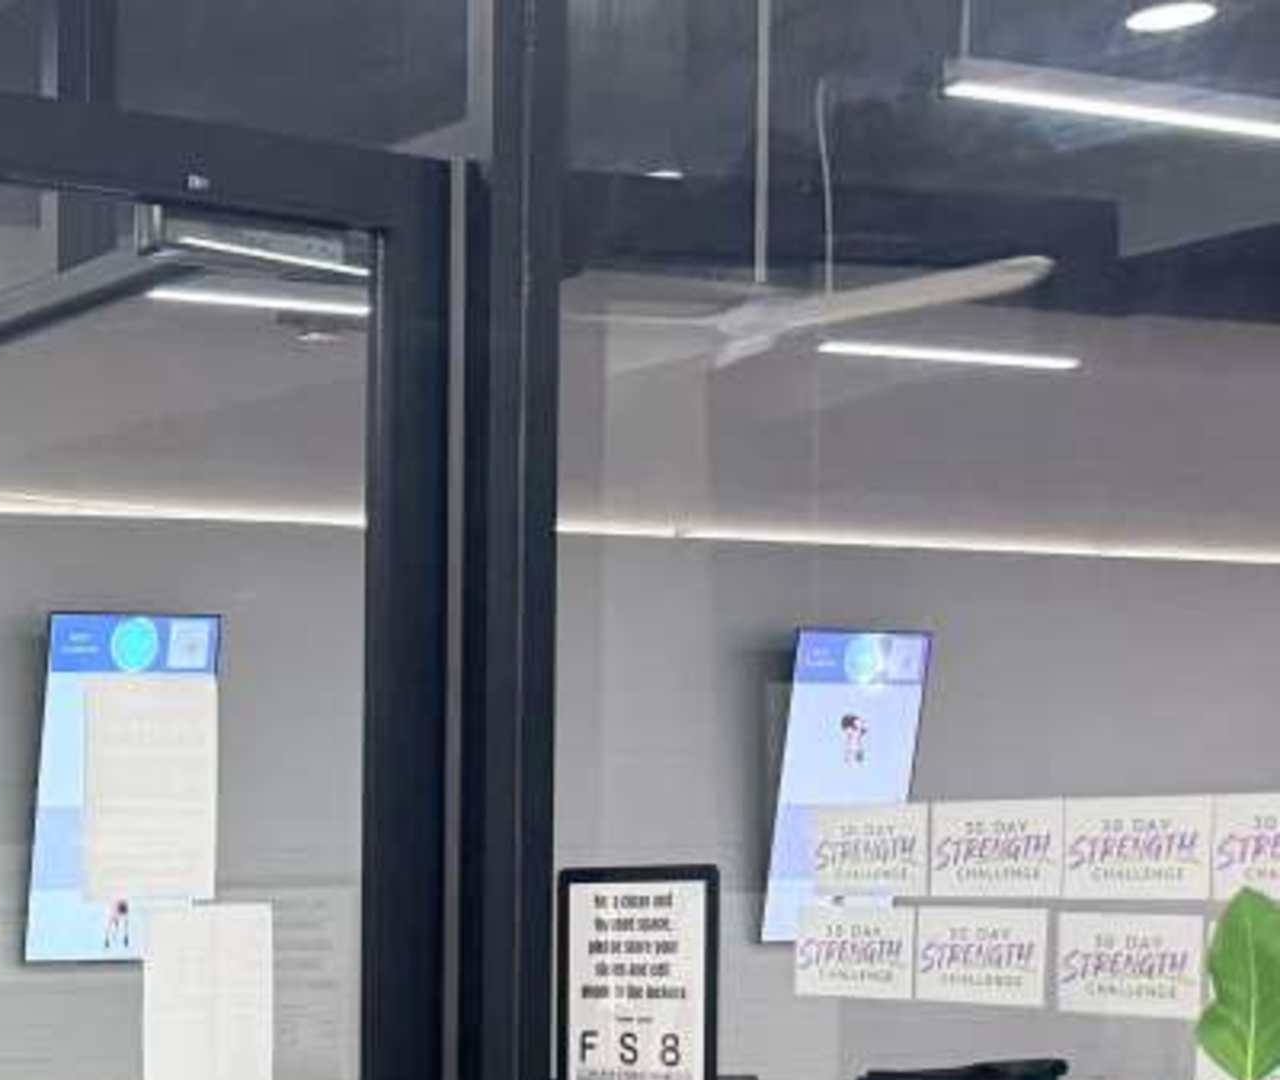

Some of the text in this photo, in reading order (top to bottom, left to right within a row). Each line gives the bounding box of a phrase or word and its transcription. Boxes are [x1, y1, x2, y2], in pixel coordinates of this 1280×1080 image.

[864, 825, 895, 836] DAY
[995, 819, 1027, 833] DAY
[1132, 818, 1171, 832] DAY
[816, 836, 917, 870] STRENGTH
[936, 831, 1052, 870] STRENGTH
[1070, 830, 1198, 870] STRENGTH
[836, 867, 907, 879] CHALLENGE
[956, 867, 1039, 881] CHALLENGE
[1091, 867, 1184, 880] CHALLENGE
[852, 925, 881, 937] DAY
[977, 927, 1012, 941] DAY
[1126, 934, 1163, 949] DAY
[798, 939, 903, 970] STRENGTH
[921, 941, 1035, 973] STRENGTH
[1060, 949, 1188, 982] STRENGTH
[819, 969, 893, 983] CHALLENGE
[942, 973, 1024, 987] CHALLENGE
[1085, 978, 1176, 999] CHALLENGE
